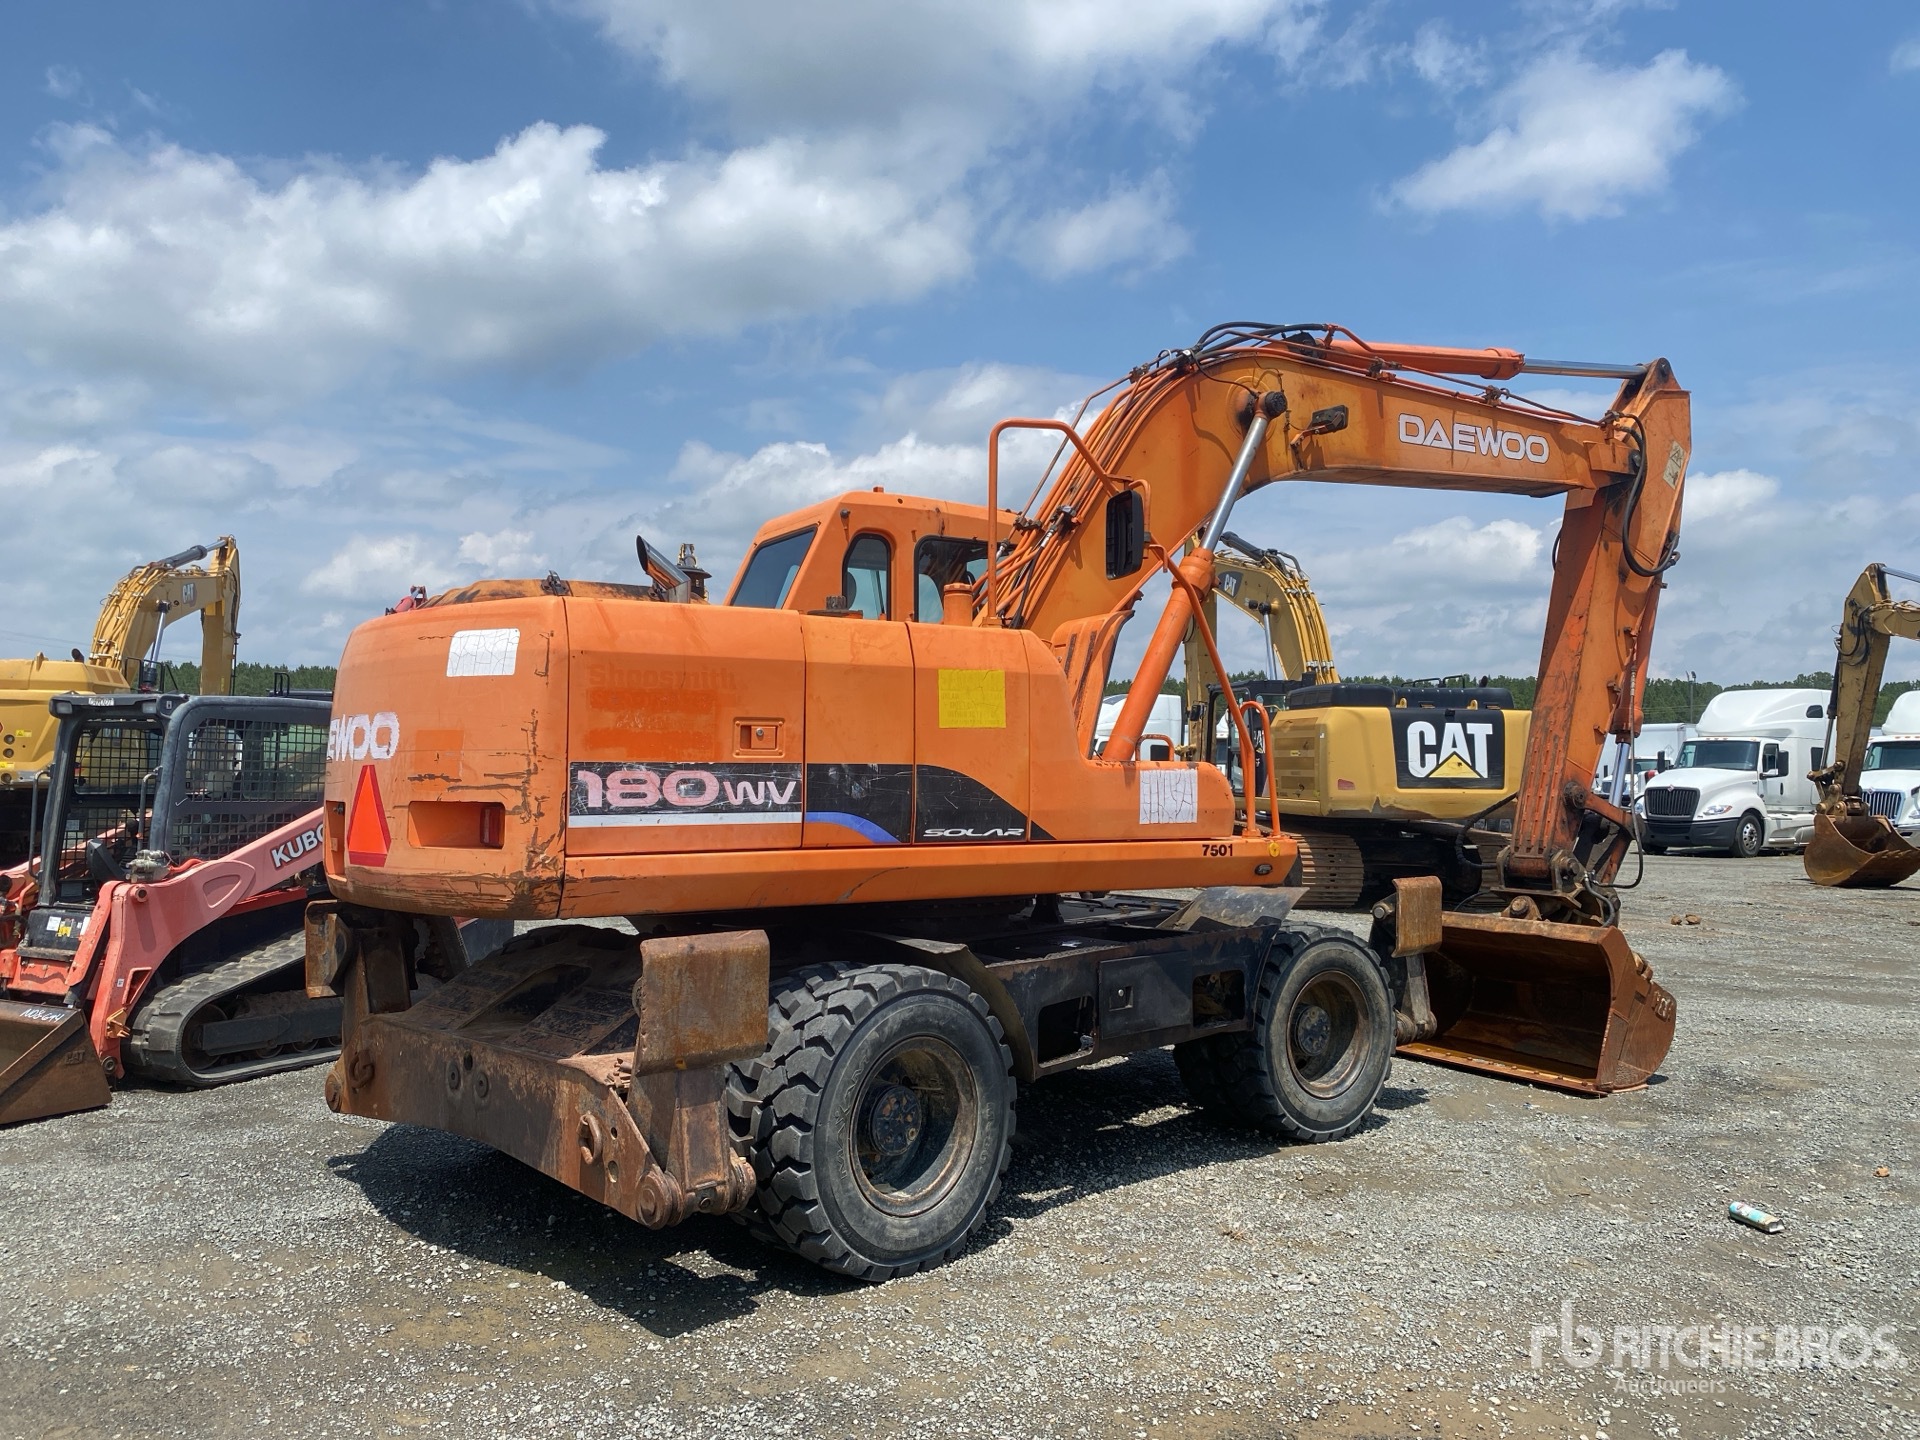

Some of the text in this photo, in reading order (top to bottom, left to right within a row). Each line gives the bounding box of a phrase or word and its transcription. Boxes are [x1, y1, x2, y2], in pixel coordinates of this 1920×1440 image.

[1398, 412, 1550, 464] DAEWOO
[1223, 573, 1237, 597] CAT
[1407, 720, 1493, 778] CAT
[923, 828, 1025, 837] SOLAR
[1202, 843, 1233, 857] 7501
